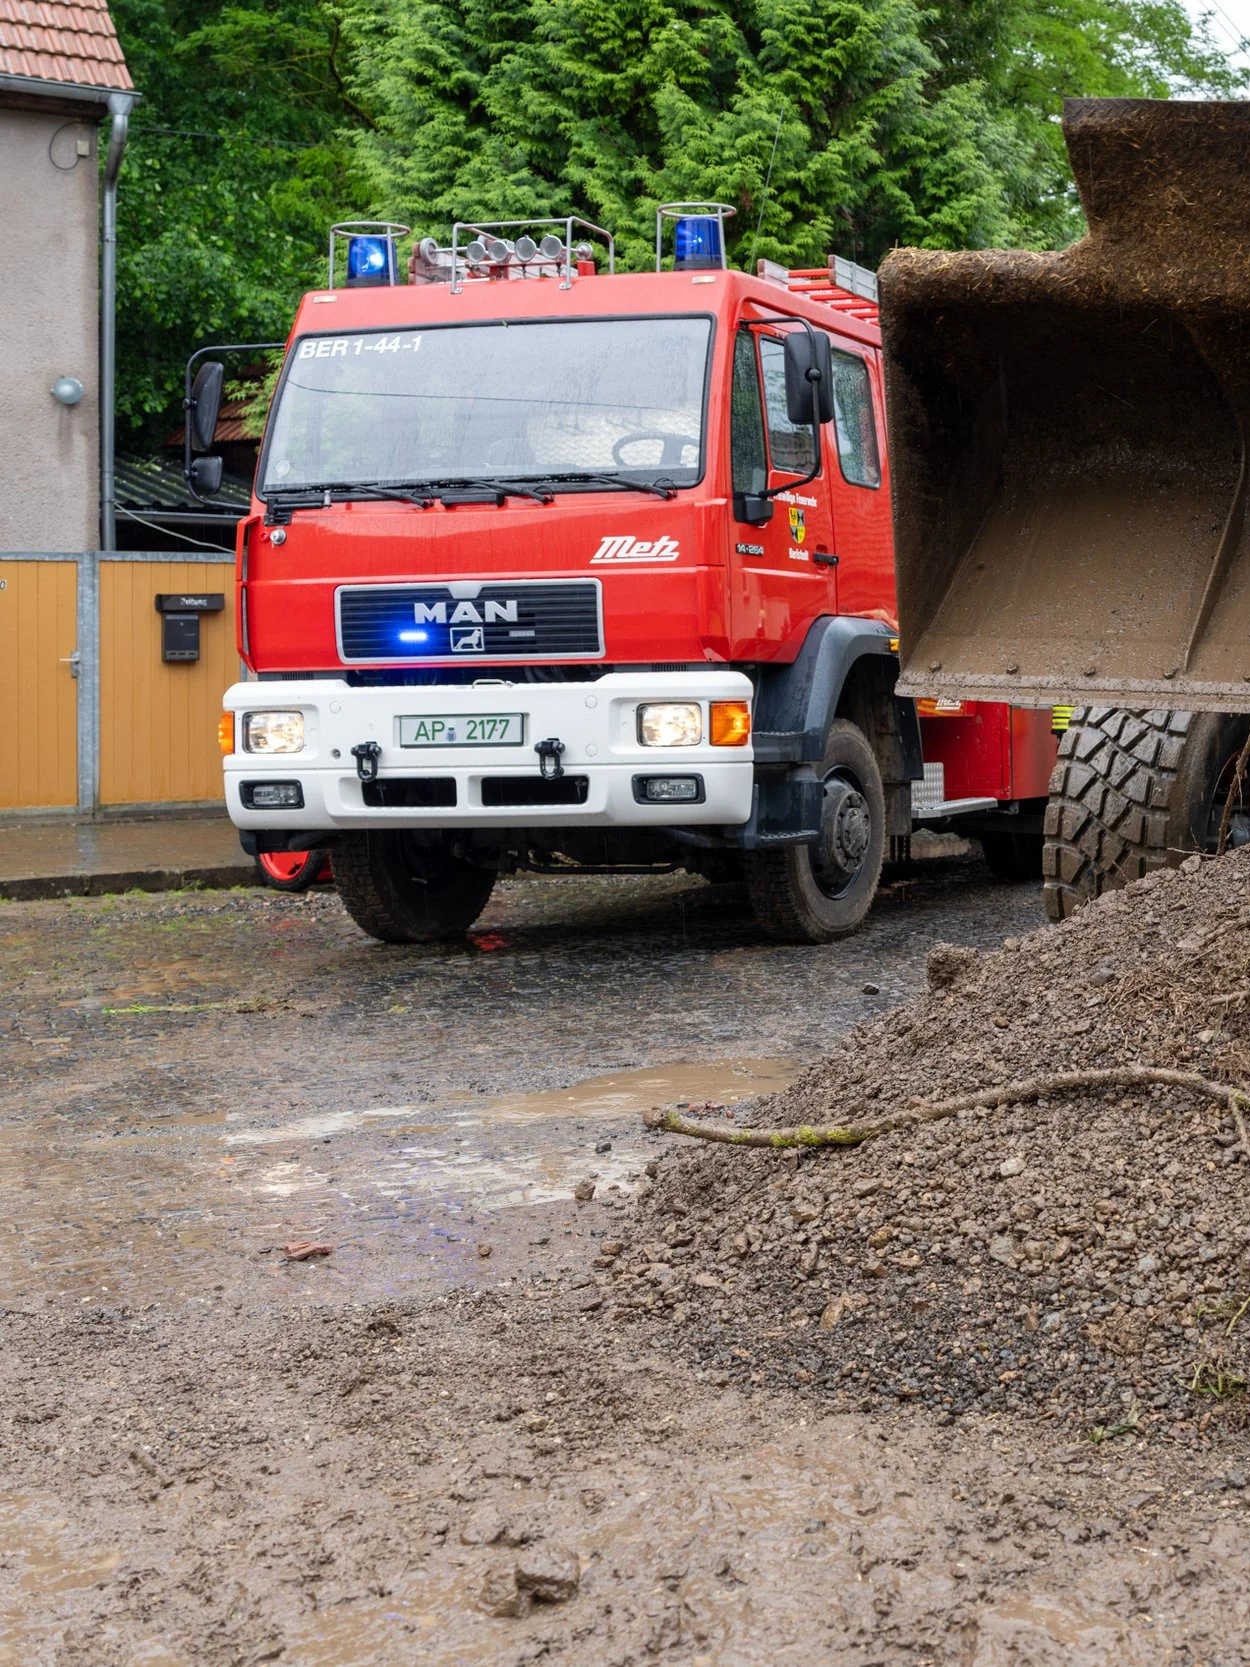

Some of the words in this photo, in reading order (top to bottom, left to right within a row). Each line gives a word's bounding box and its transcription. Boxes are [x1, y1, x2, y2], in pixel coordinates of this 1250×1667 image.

[299, 339, 349, 359] BER
[352, 335, 423, 356] 1-44-1
[589, 535, 680, 564] Metz
[413, 600, 518, 625] MAN
[466, 718, 510, 741] 2177
